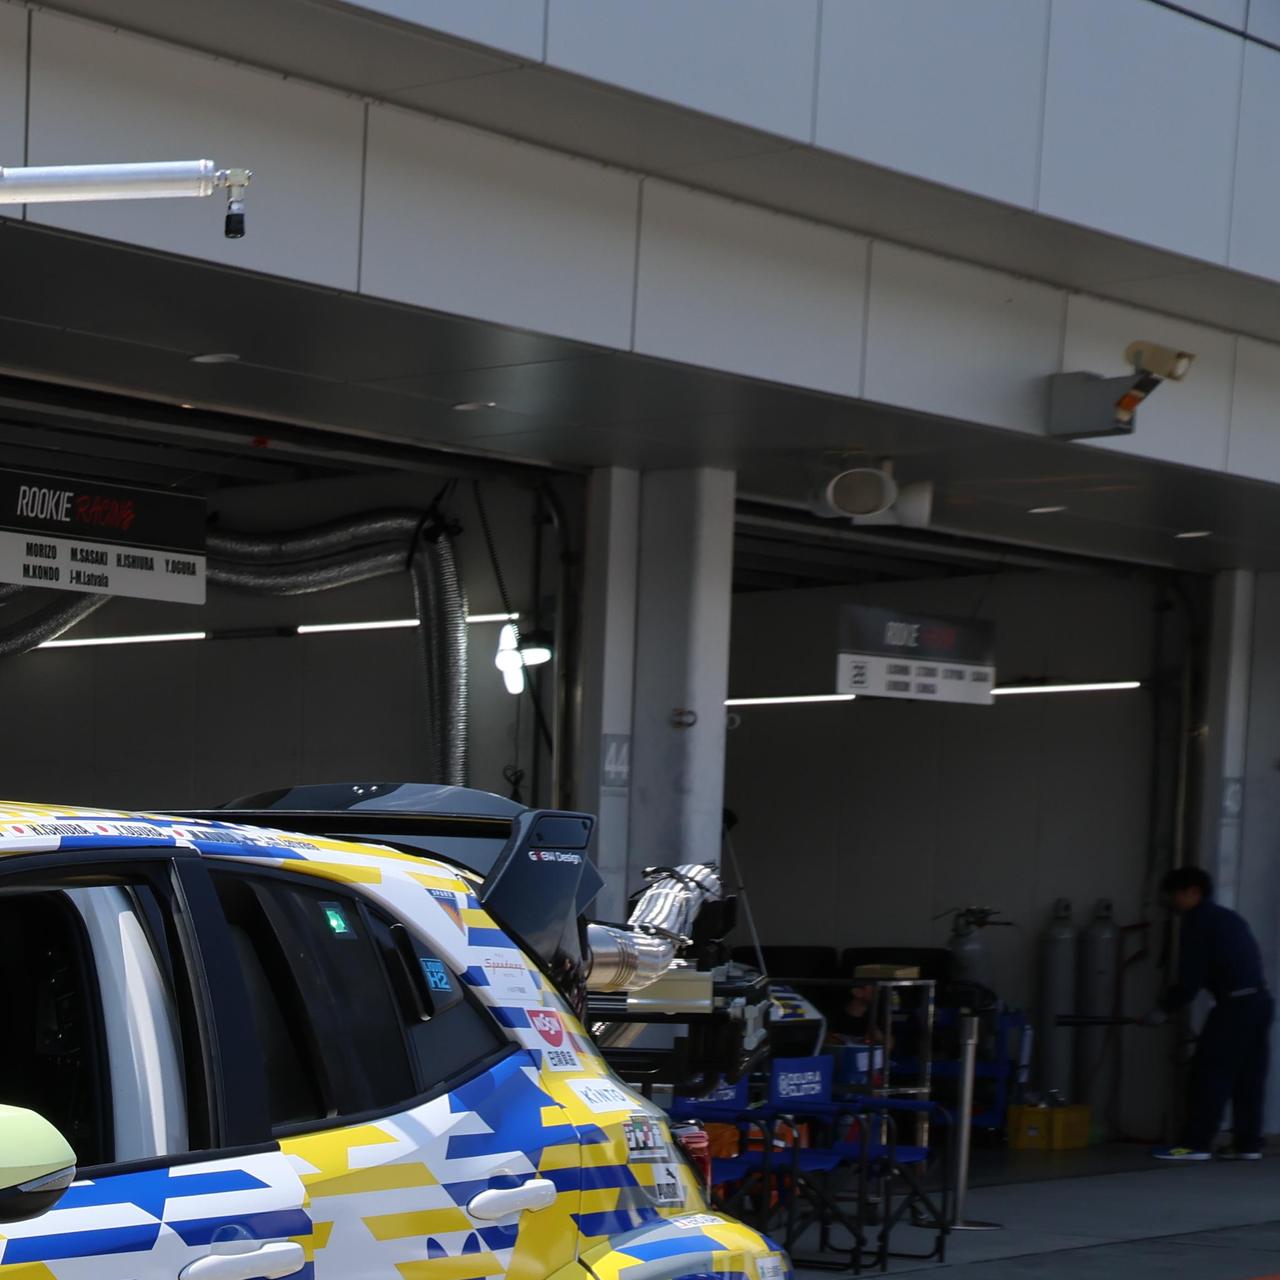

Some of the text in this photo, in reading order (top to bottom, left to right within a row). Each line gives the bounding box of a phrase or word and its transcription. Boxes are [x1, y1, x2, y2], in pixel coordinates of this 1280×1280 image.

[17, 485, 75, 522] ROOKIE
[26, 542, 57, 560] MORIZO
[70, 548, 108, 566] M.SASAKI
[23, 563, 60, 582] M.KONDO
[427, 971, 451, 989] H2
